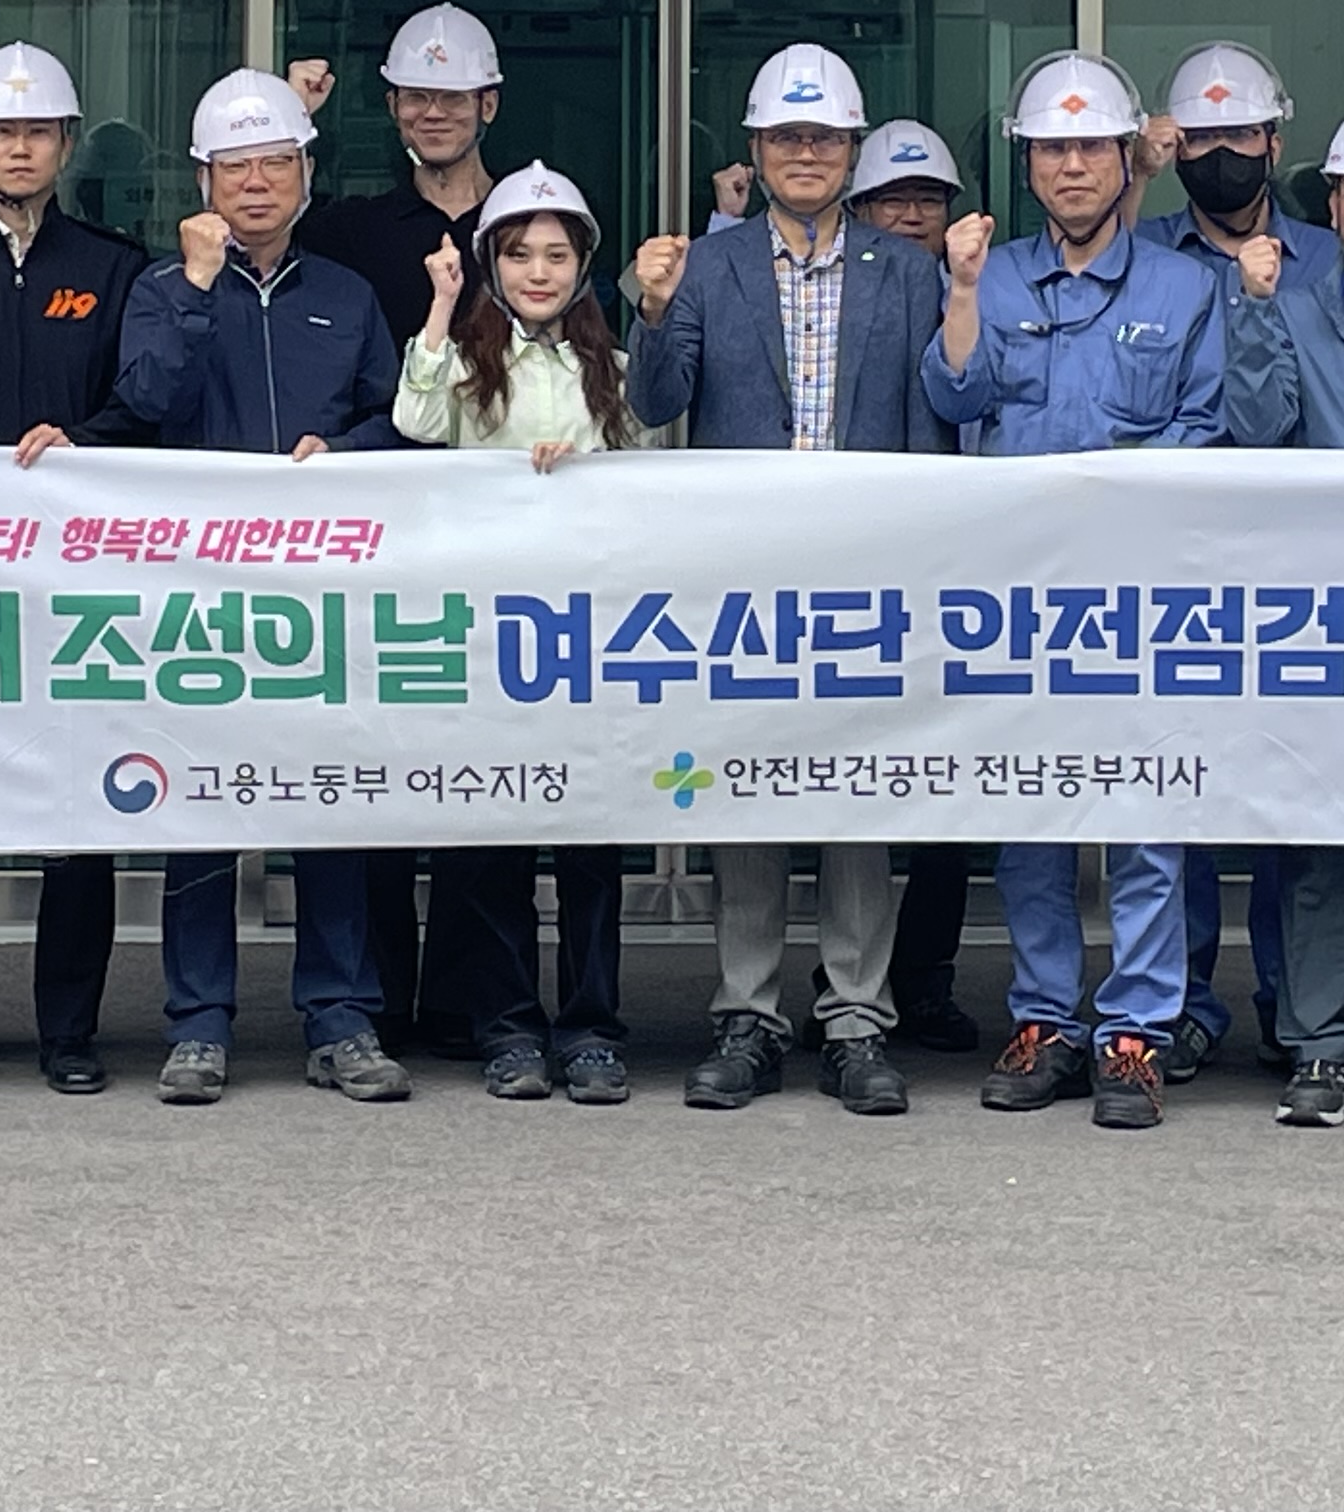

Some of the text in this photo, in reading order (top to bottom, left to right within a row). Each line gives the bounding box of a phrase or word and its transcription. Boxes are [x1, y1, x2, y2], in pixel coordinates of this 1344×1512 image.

[43, 289, 98, 318] 119
[60, 516, 191, 563] 행복한
[197, 518, 382, 564] 대한민국!
[50, 591, 345, 705] 조성의
[374, 591, 474, 705] 날
[495, 590, 909, 701] 여수산단
[186, 761, 569, 804] 고용노동부 여수지청
[724, 754, 1206, 799] 안전보건공단 전남동부지사
